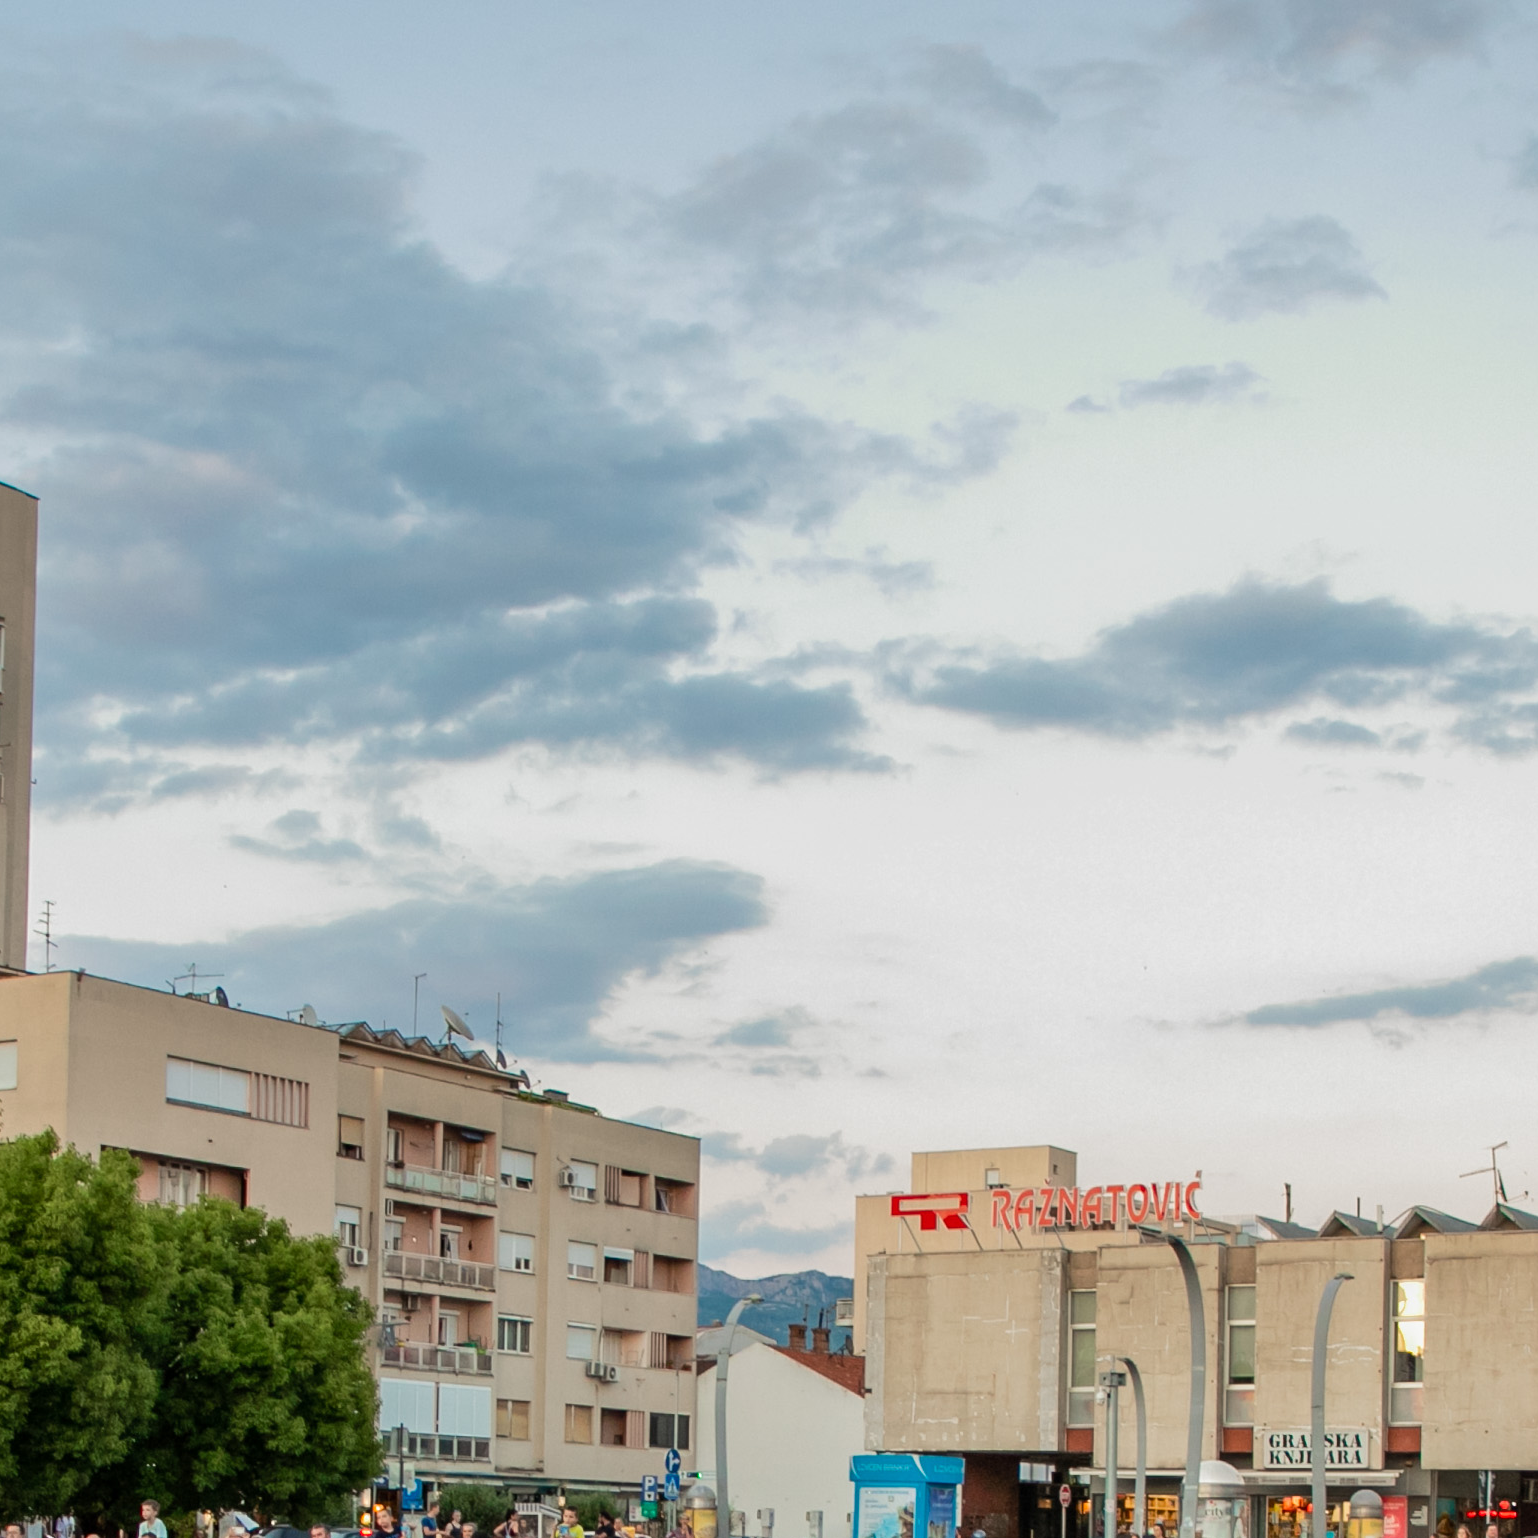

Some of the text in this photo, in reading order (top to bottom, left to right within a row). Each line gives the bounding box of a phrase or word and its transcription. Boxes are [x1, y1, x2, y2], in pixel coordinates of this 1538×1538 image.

[992, 1169, 1203, 1233] RAŽNATOVIĆ
[1268, 1433, 1363, 1448] GRASKA
[1268, 1451, 1363, 1465] KNJIARA
[645, 1477, 655, 1490] P
